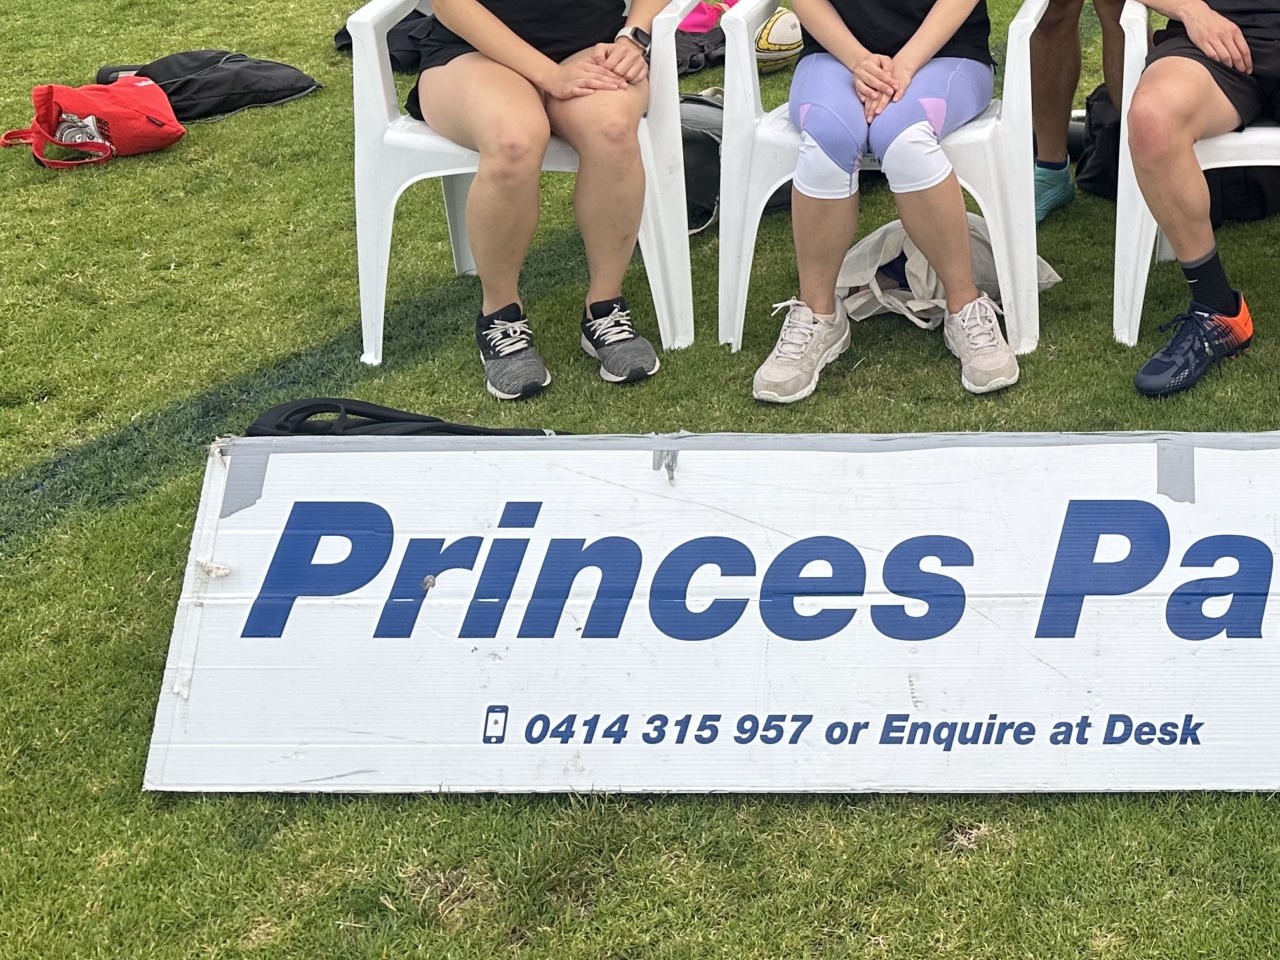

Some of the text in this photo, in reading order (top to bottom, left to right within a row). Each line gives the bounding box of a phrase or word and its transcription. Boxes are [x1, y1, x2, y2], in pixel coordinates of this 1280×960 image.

[241, 500, 974, 642] Princes
[523, 713, 1204, 752] 0414 315 957 or Enquire at Desk
